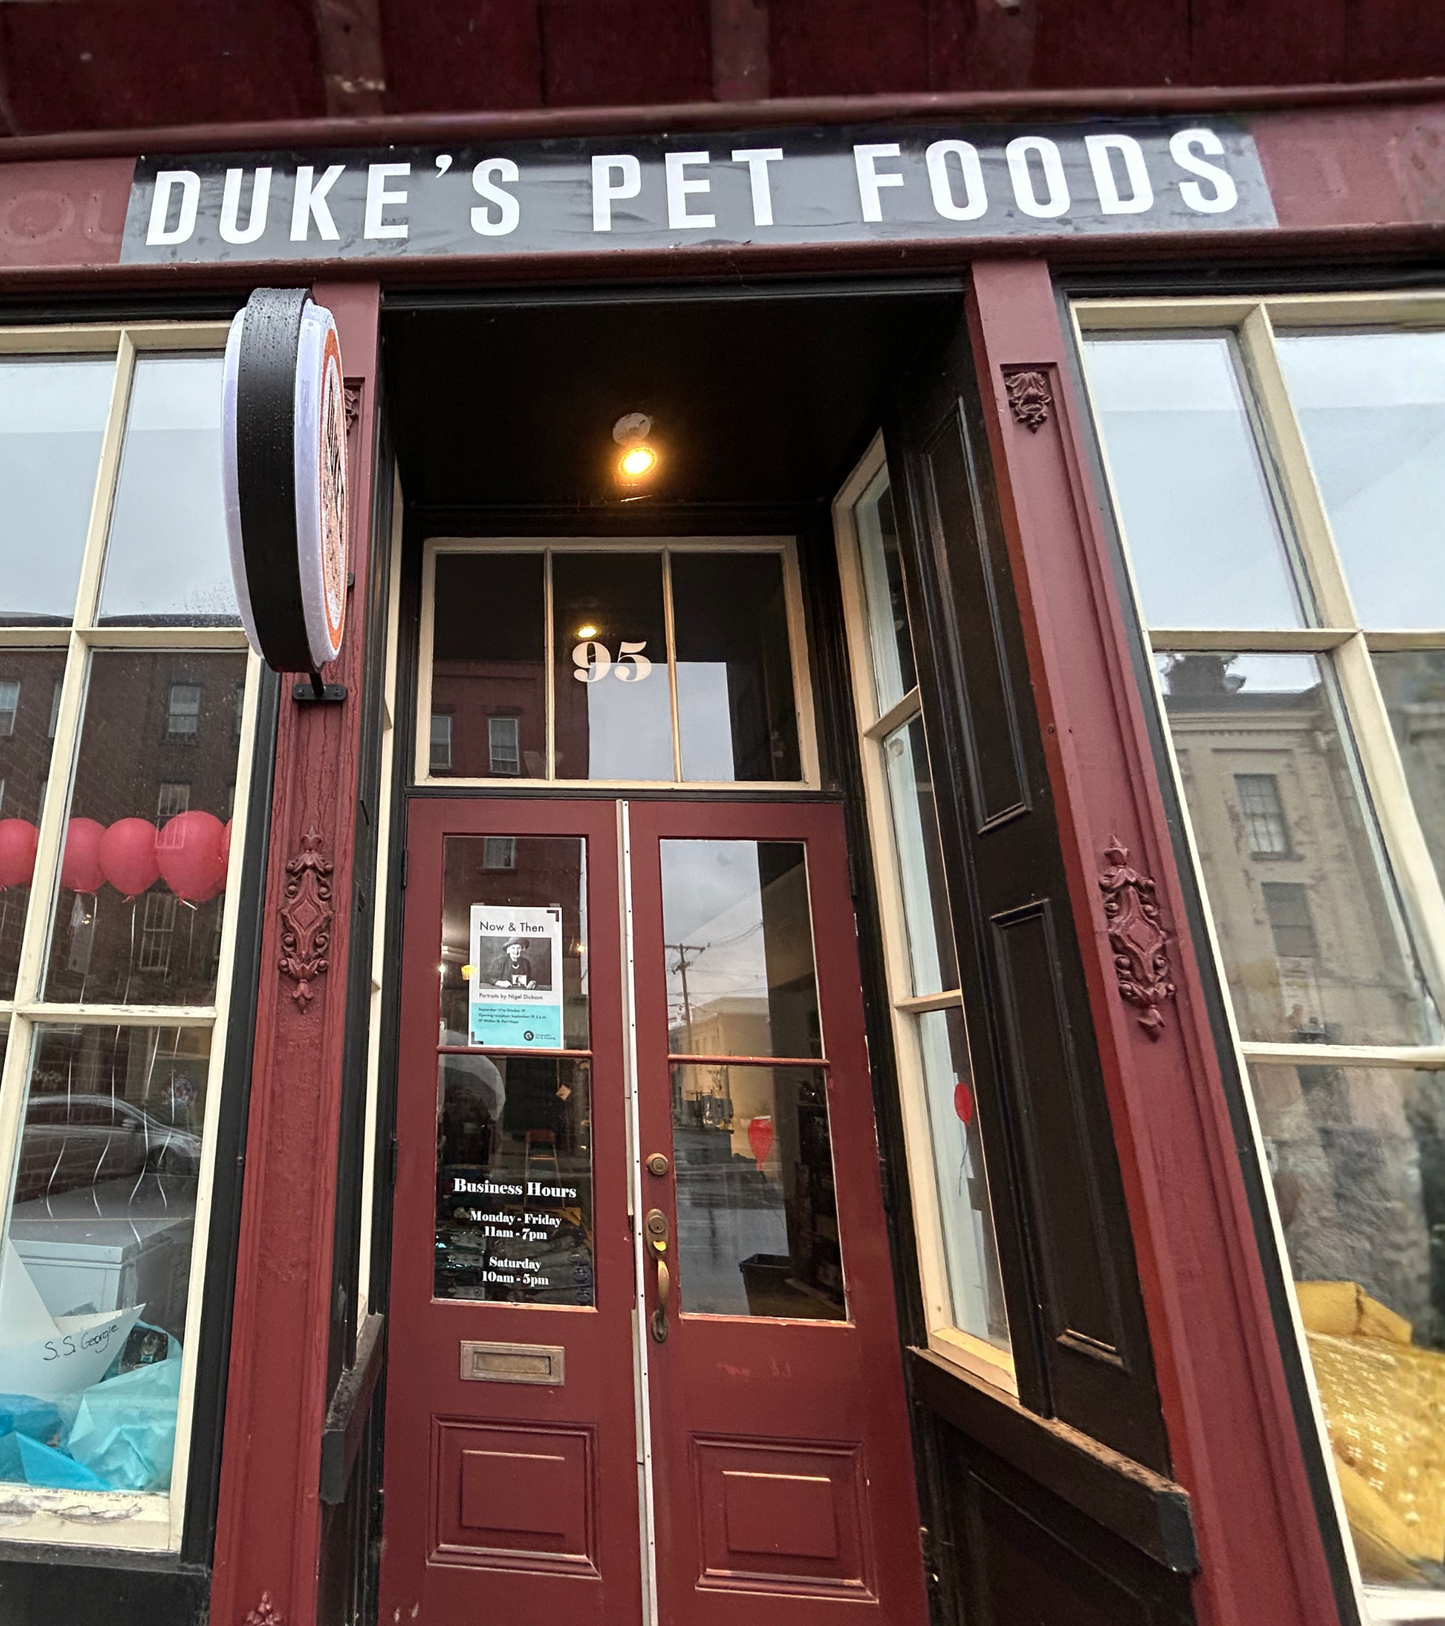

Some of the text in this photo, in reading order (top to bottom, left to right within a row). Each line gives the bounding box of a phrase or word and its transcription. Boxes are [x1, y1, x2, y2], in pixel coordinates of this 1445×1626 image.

[145, 154, 519, 246] DUKE'S
[591, 147, 783, 232] PET
[853, 128, 1239, 222] FOODS
[572, 641, 652, 683] 95
[480, 921, 544, 932] Now & Then
[454, 1178, 577, 1198] Business Hours
[470, 1210, 515, 1226] Monday
[524, 1213, 562, 1228] Friday
[484, 1226, 513, 1238] 11am
[522, 1228, 548, 1241] 7pm
[489, 1256, 542, 1272] Saturday
[482, 1271, 514, 1283] 10am
[522, 1274, 549, 1286] 5pm
